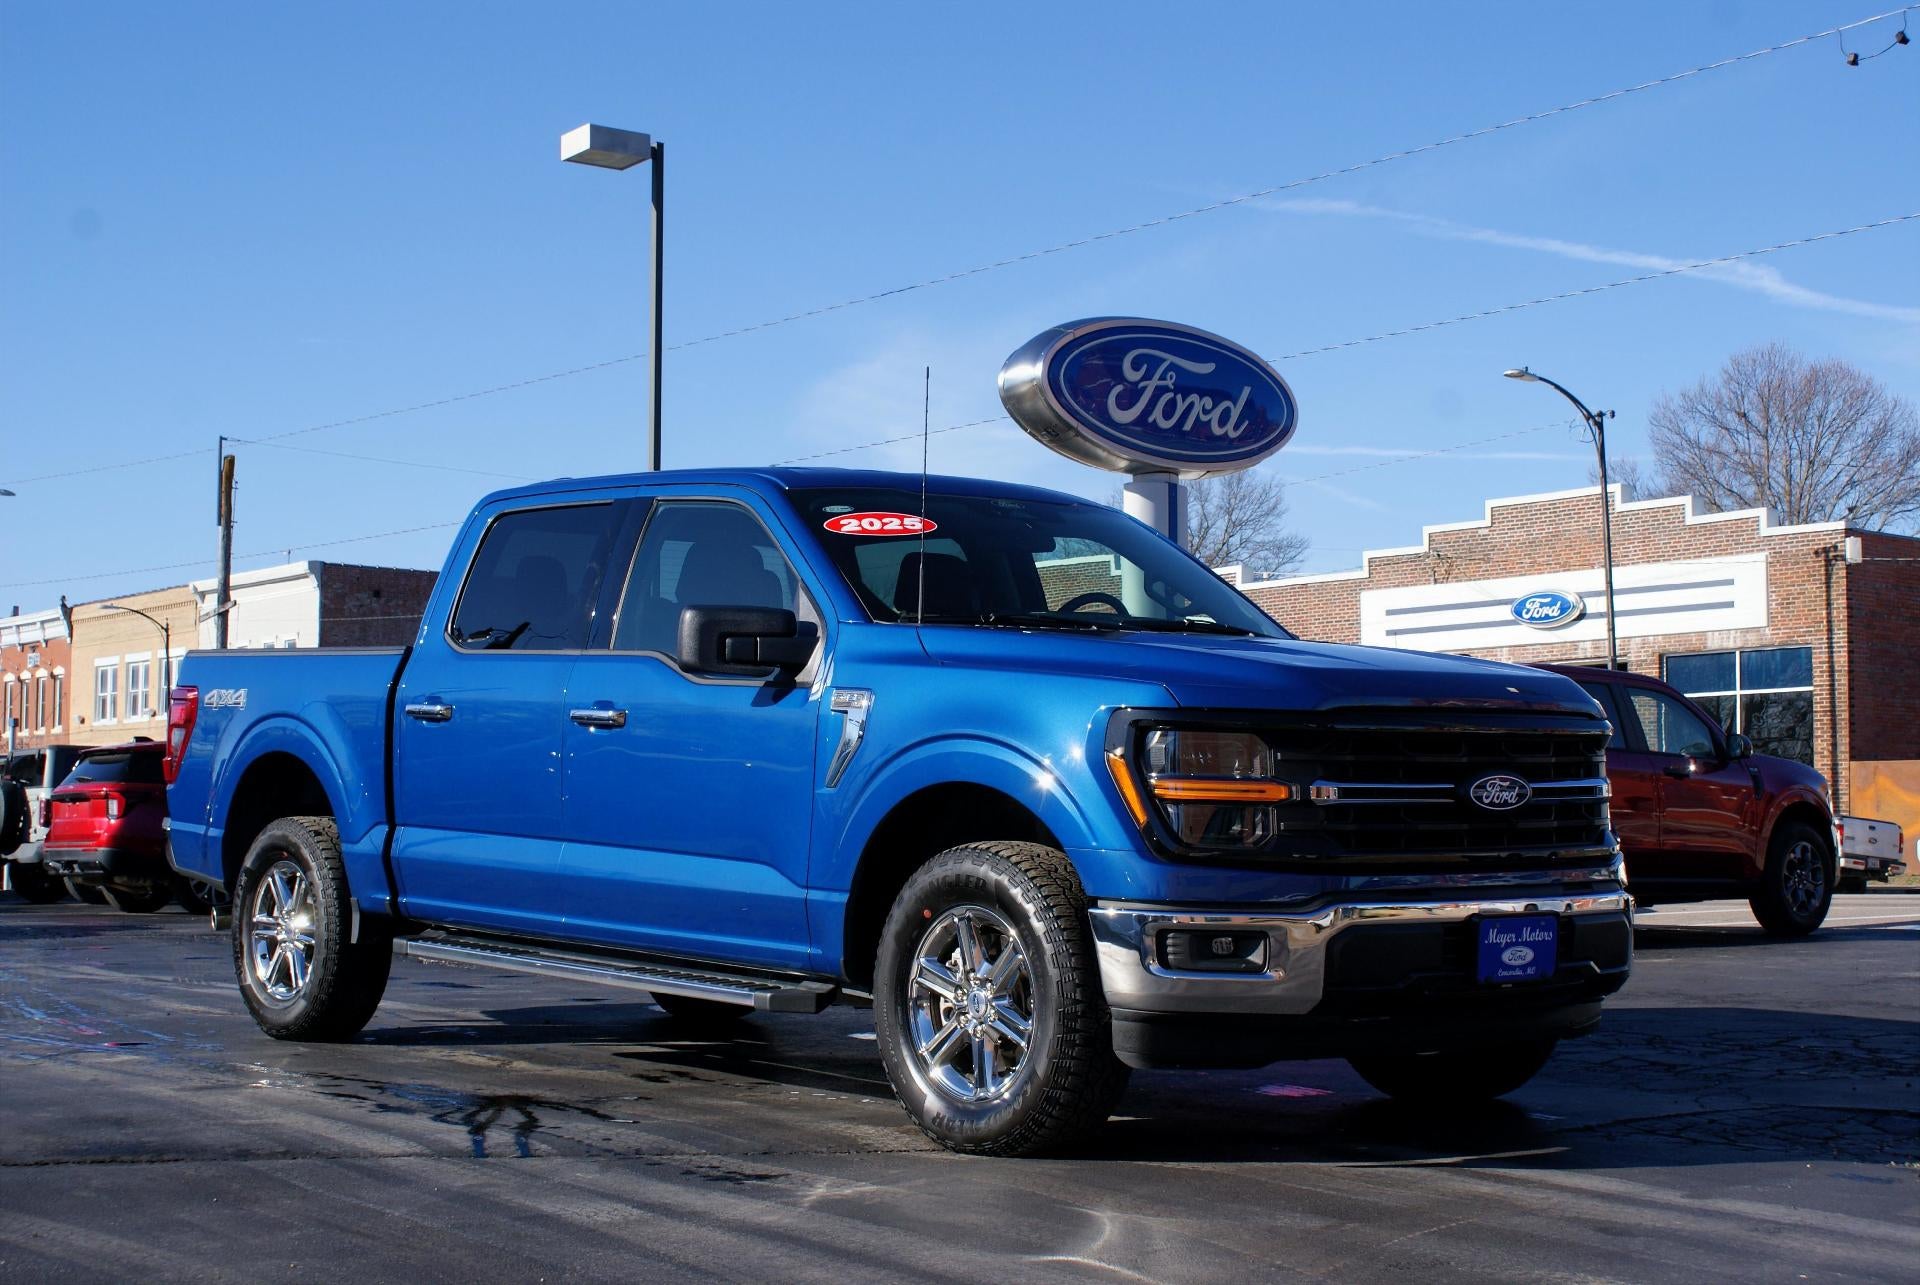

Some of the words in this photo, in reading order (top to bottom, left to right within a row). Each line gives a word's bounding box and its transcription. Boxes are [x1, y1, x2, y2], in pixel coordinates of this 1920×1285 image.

[1107, 348, 1251, 439] Ford
[839, 518, 923, 532] 2025
[1521, 597, 1562, 619] Ford
[1482, 780, 1520, 804] Ford
[1485, 928, 1517, 948] Meyer
[1519, 926, 1553, 942] Motors
[1507, 949, 1528, 962] Ford
